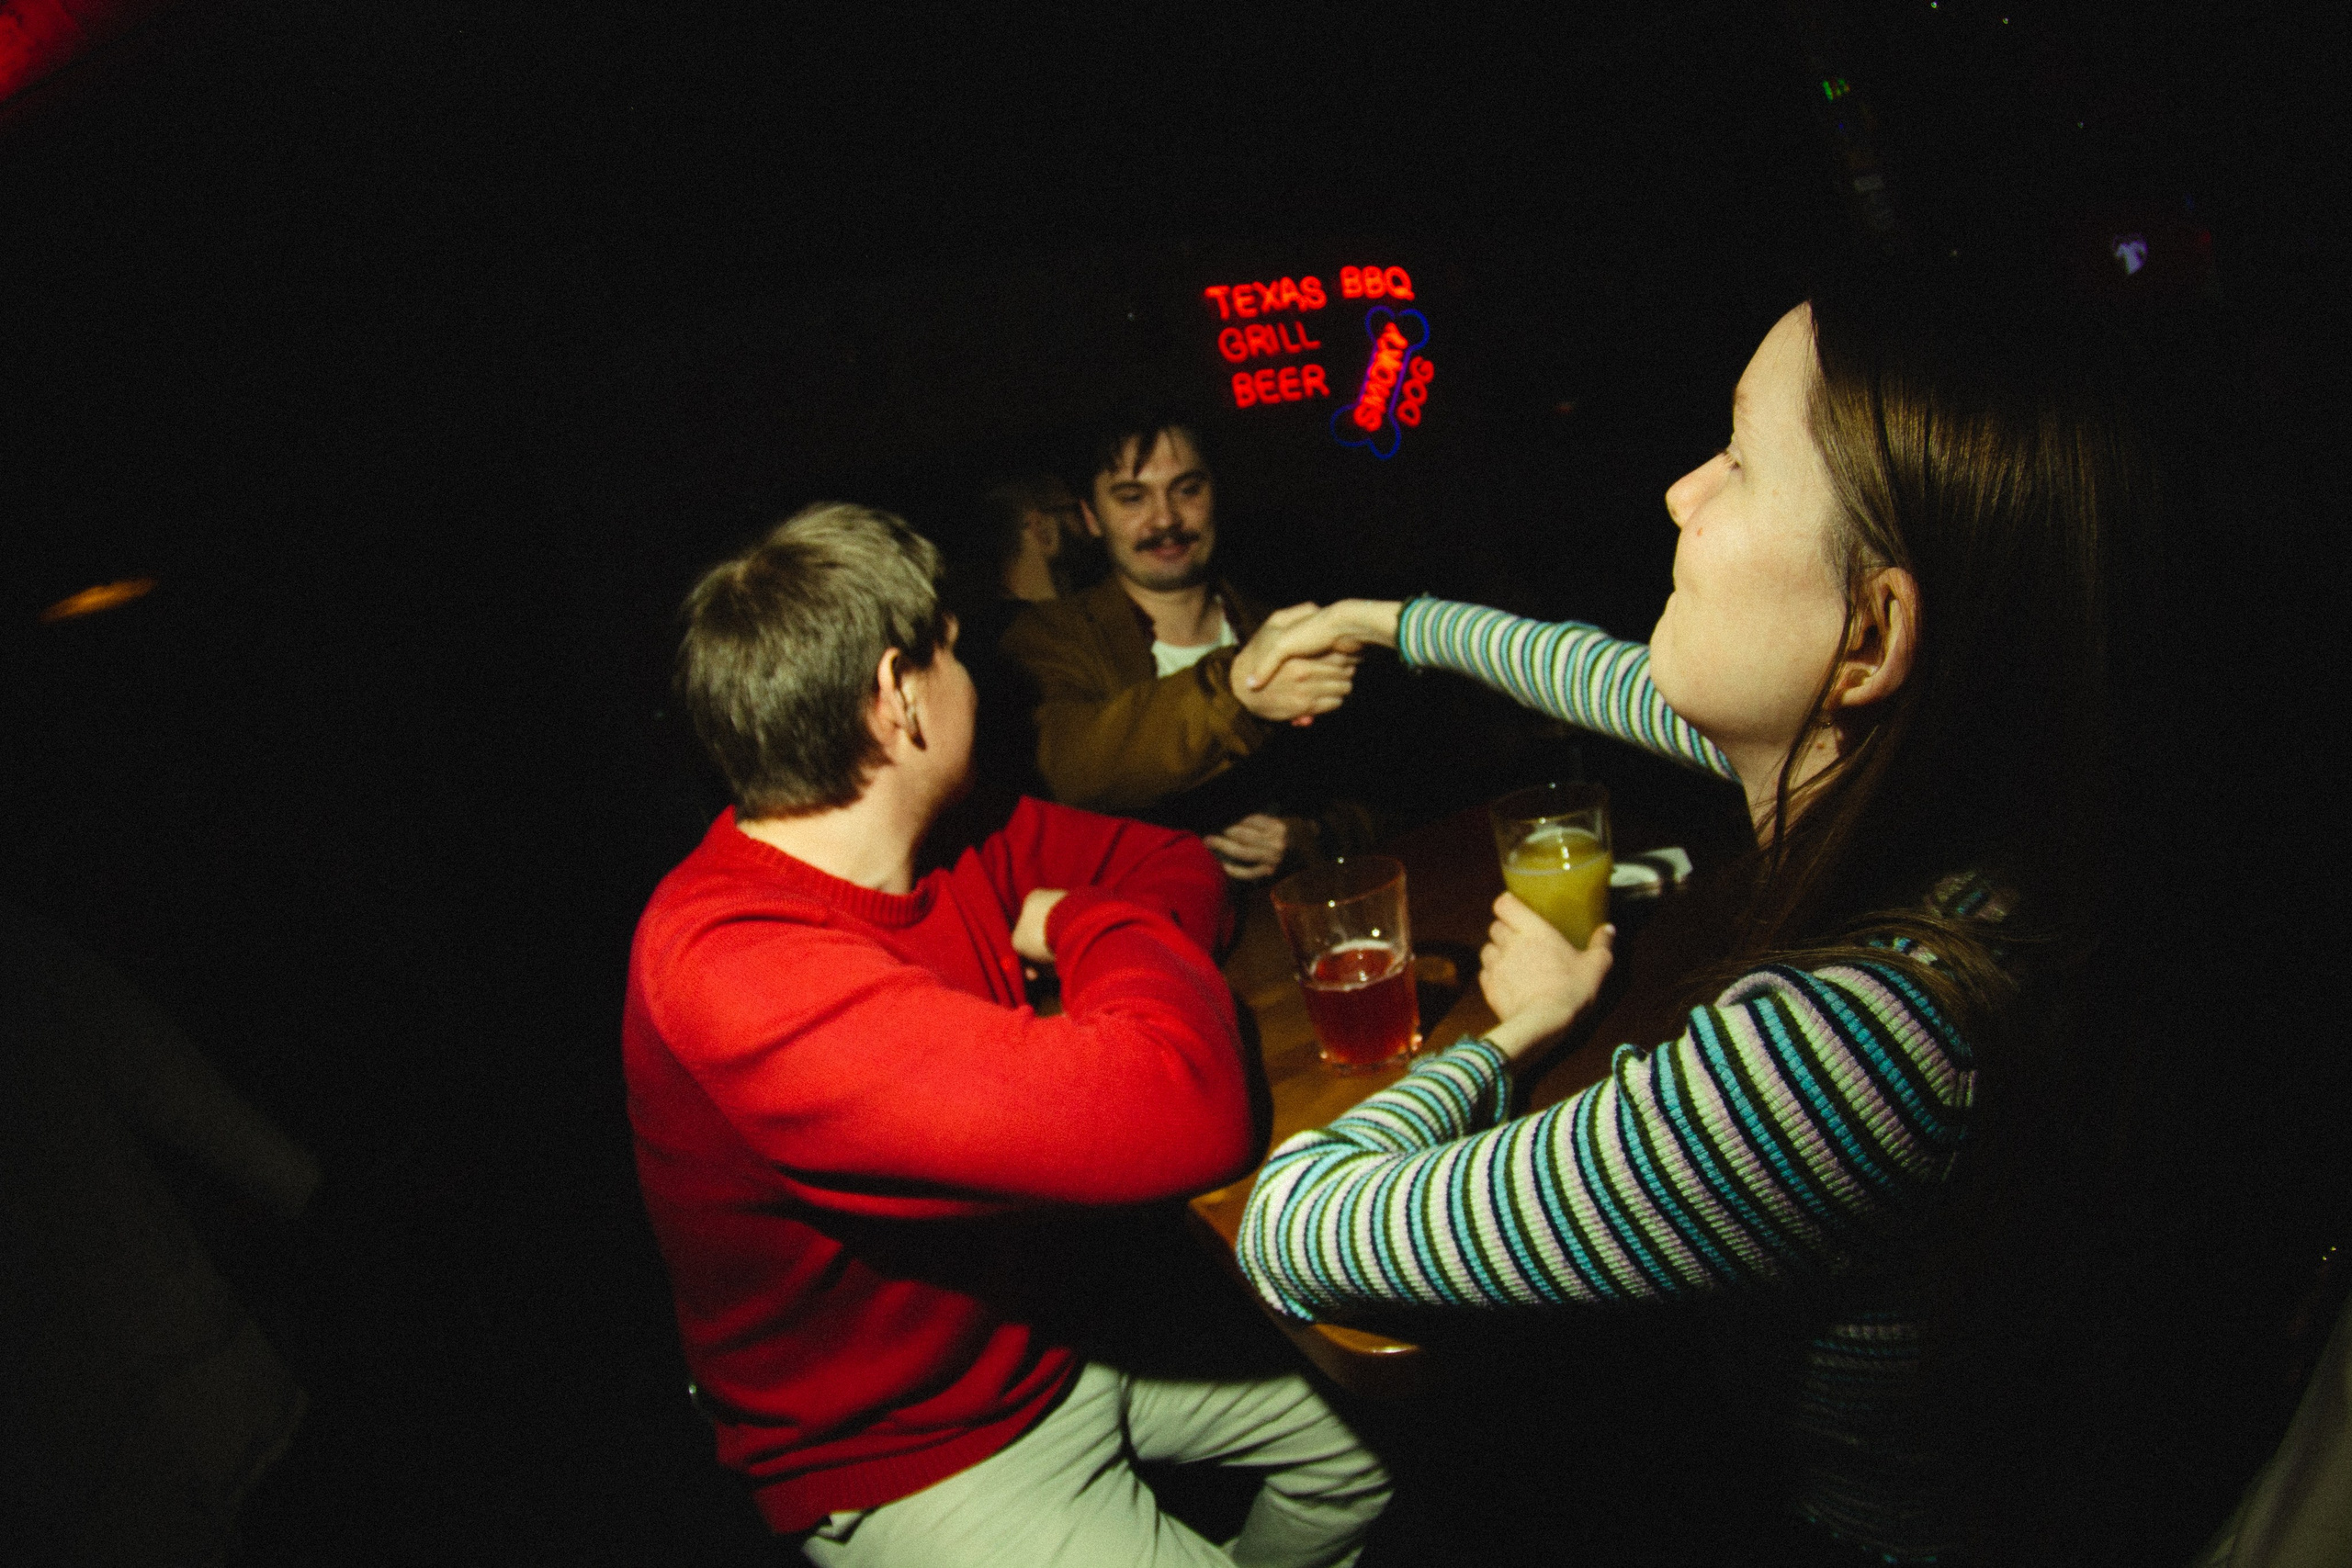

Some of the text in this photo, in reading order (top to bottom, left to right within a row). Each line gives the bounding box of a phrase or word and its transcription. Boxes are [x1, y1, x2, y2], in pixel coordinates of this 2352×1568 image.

[1204, 265, 1415, 320] TEXAS BBQ
[1217, 321, 1321, 363] GRILL
[1231, 364, 1329, 409] BEER
[1354, 322, 1408, 432] SMOKY
[1396, 355, 1435, 427] DOG
